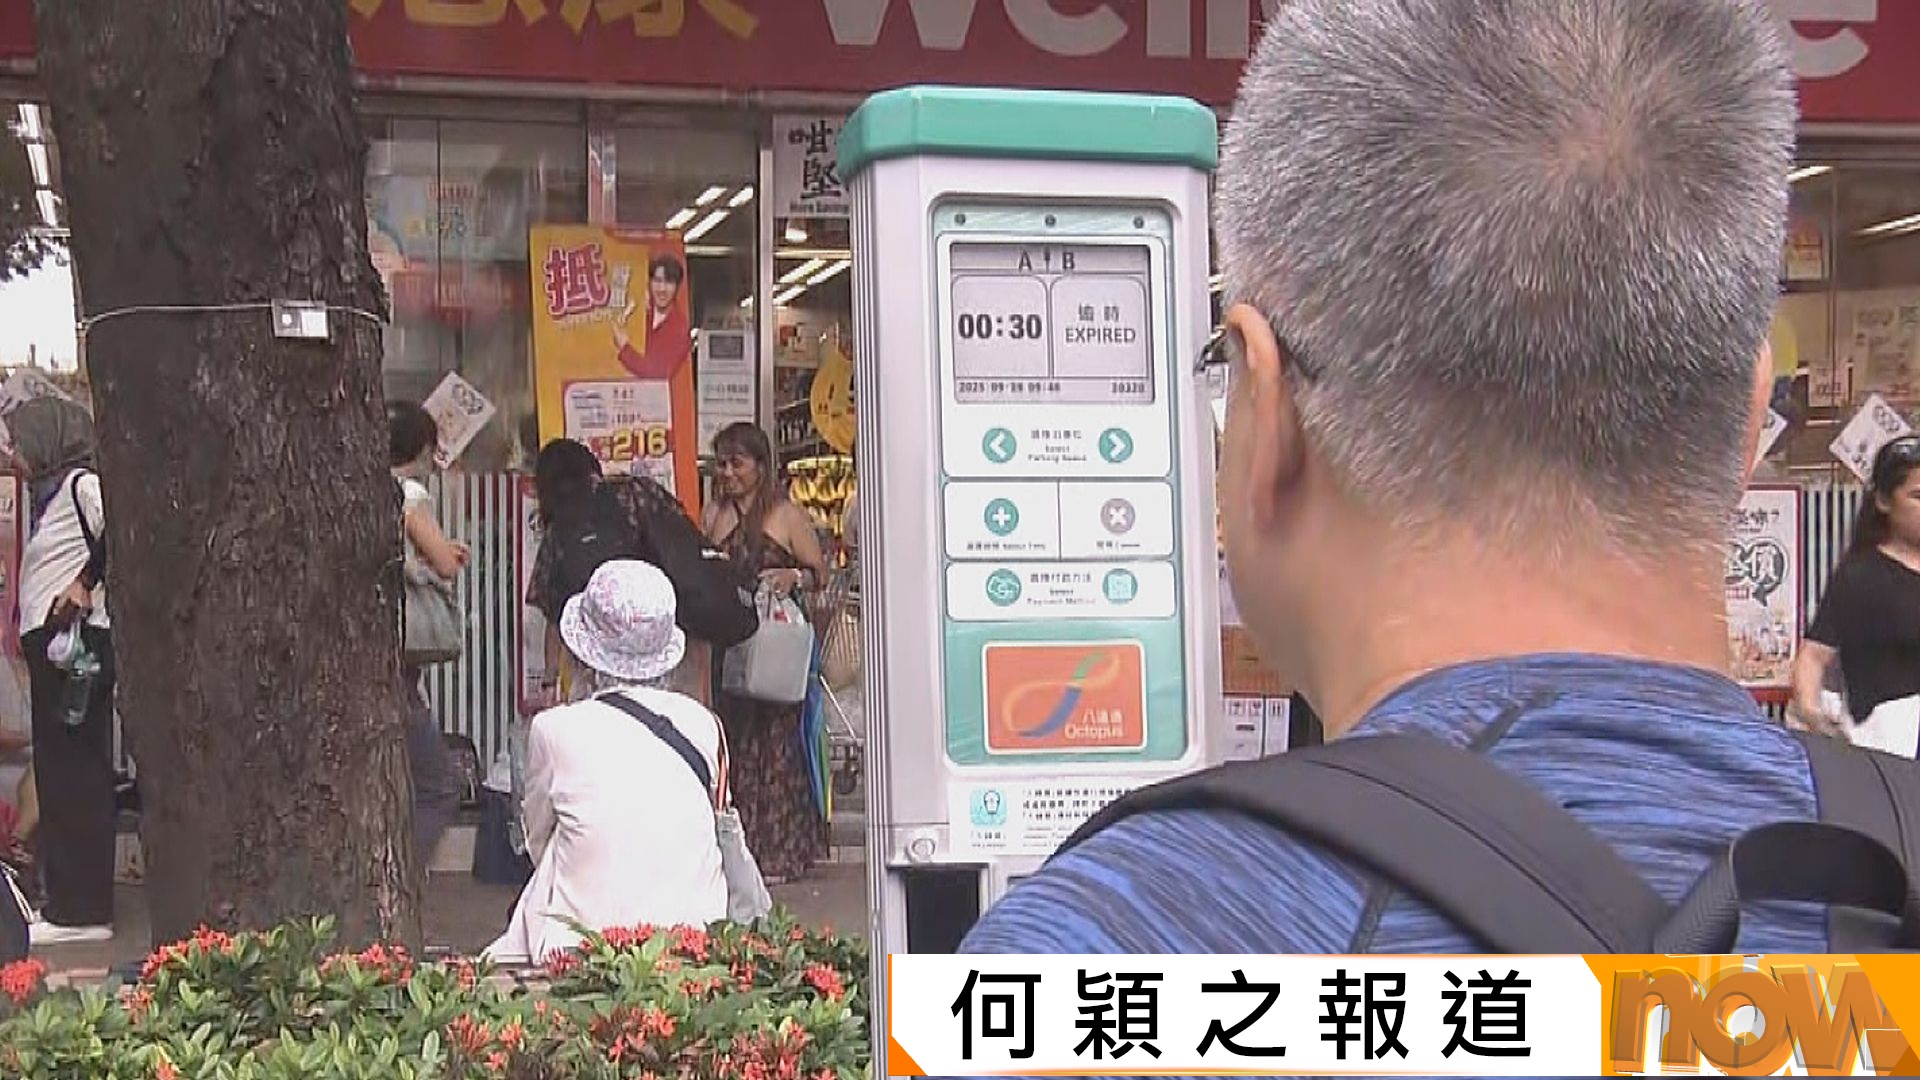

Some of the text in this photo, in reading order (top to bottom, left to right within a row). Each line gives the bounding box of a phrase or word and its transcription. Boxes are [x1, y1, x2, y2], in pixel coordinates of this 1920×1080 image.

[1018, 251, 1076, 271] A B
[545, 243, 611, 315] 抵
[958, 313, 1043, 339] 00:30
[1065, 327, 1136, 344] EXPIRED
[1064, 723, 1123, 740] Octopus
